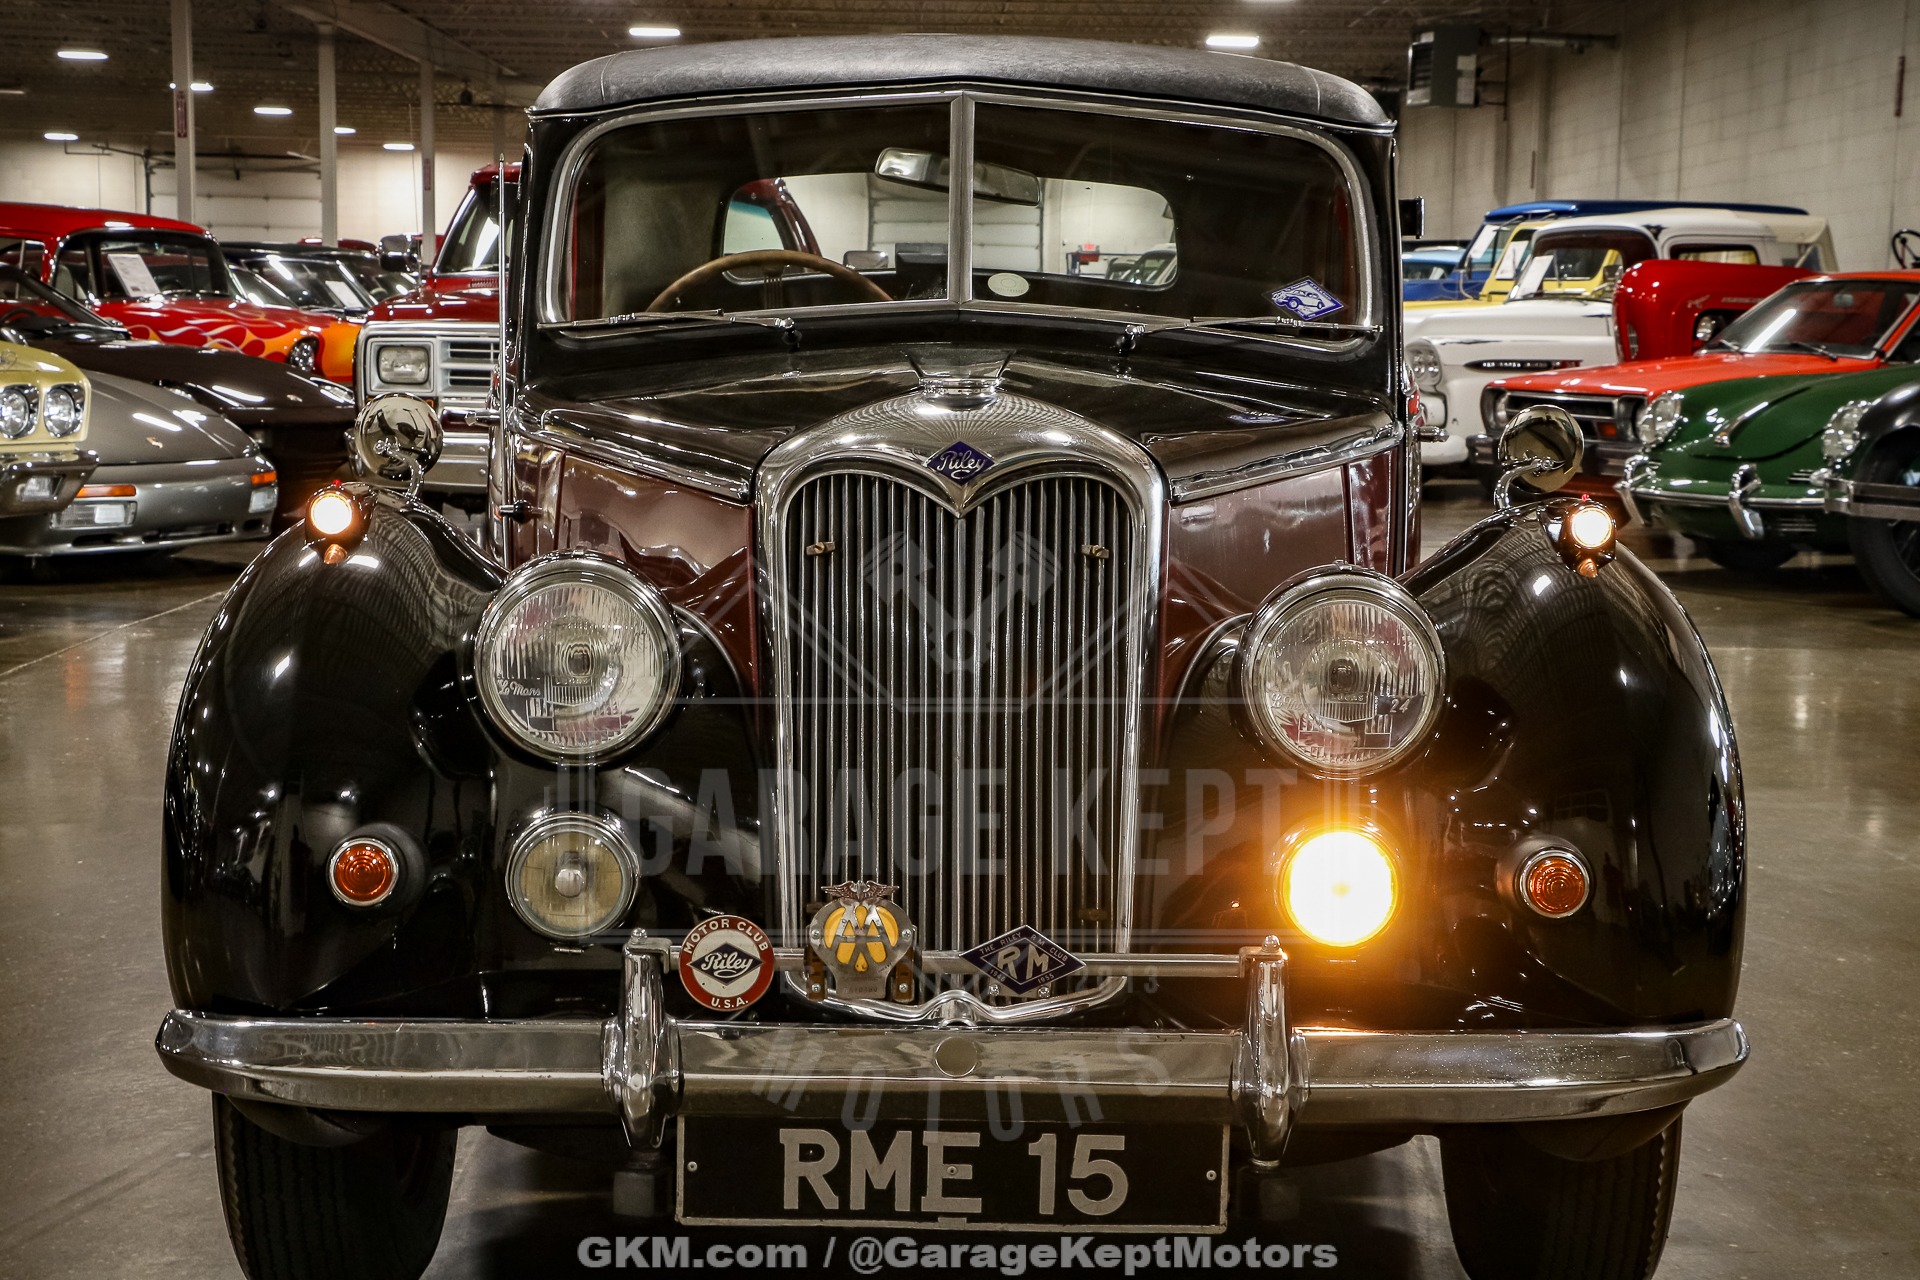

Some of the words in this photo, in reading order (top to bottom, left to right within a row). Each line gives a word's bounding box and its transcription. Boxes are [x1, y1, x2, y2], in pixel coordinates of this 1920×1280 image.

[937, 450, 986, 479] Riley
[1390, 699, 1410, 713] 24
[683, 918, 730, 954] MOTOR
[736, 921, 769, 951] CLUB
[979, 945, 996, 955] THE
[1000, 932, 1022, 946] RILEY
[1049, 947, 1069, 962] CLUB
[701, 952, 754, 978] Riley
[997, 943, 1050, 980] RM
[1037, 973, 1055, 984] 1955
[711, 997, 749, 1009] U.S.A.
[779, 1128, 982, 1213] RME
[1028, 1132, 1129, 1216] 15
